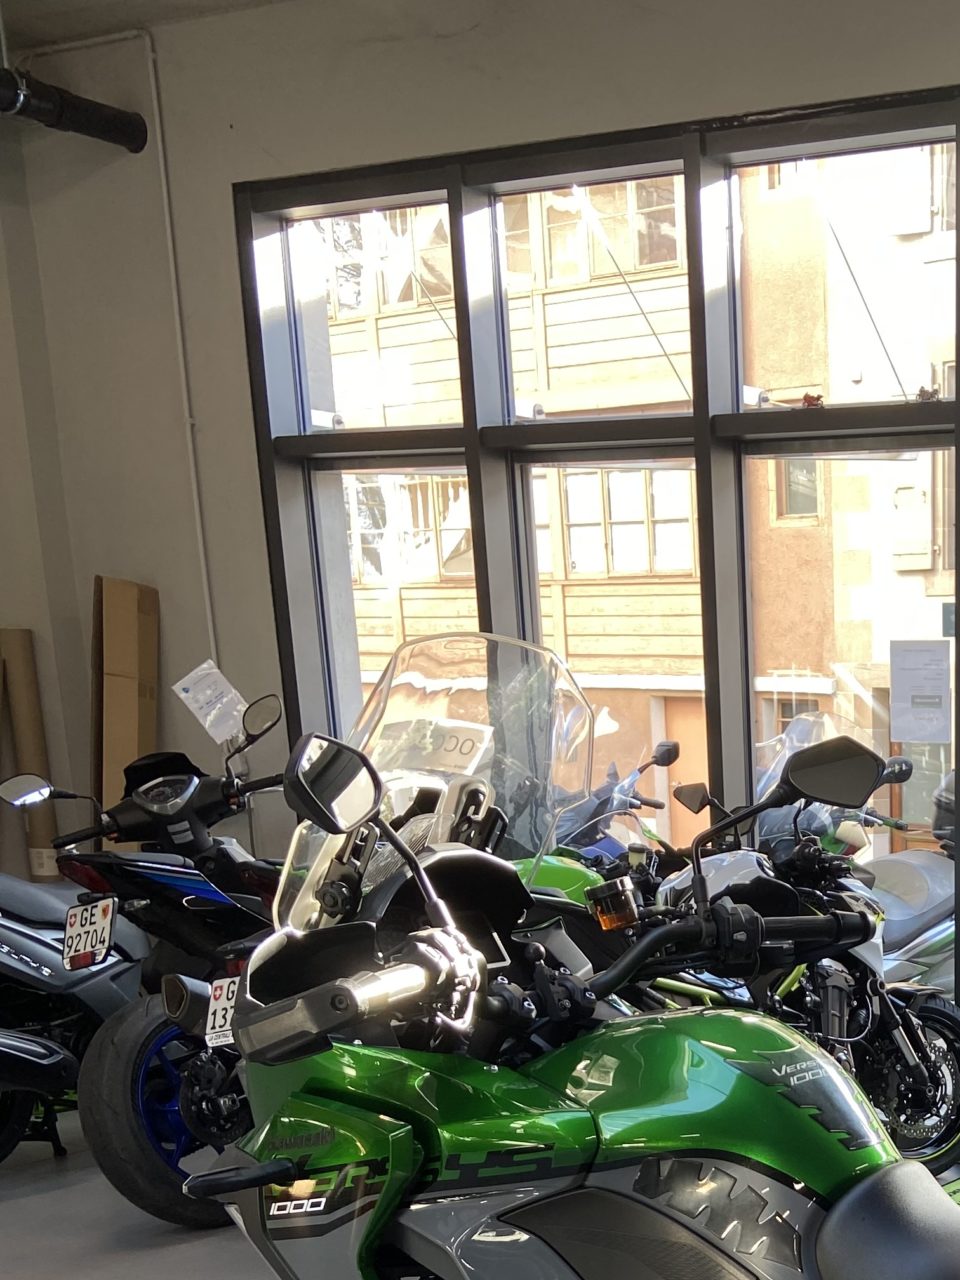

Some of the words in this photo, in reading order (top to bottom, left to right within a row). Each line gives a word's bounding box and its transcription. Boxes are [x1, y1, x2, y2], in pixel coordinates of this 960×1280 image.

[80, 905, 98, 927] GE
[66, 927, 106, 958] 92704
[226, 980, 236, 1001] G
[210, 1005, 235, 1030] 13
[772, 1059, 818, 1077] VERS
[269, 1198, 326, 1216] 1000
